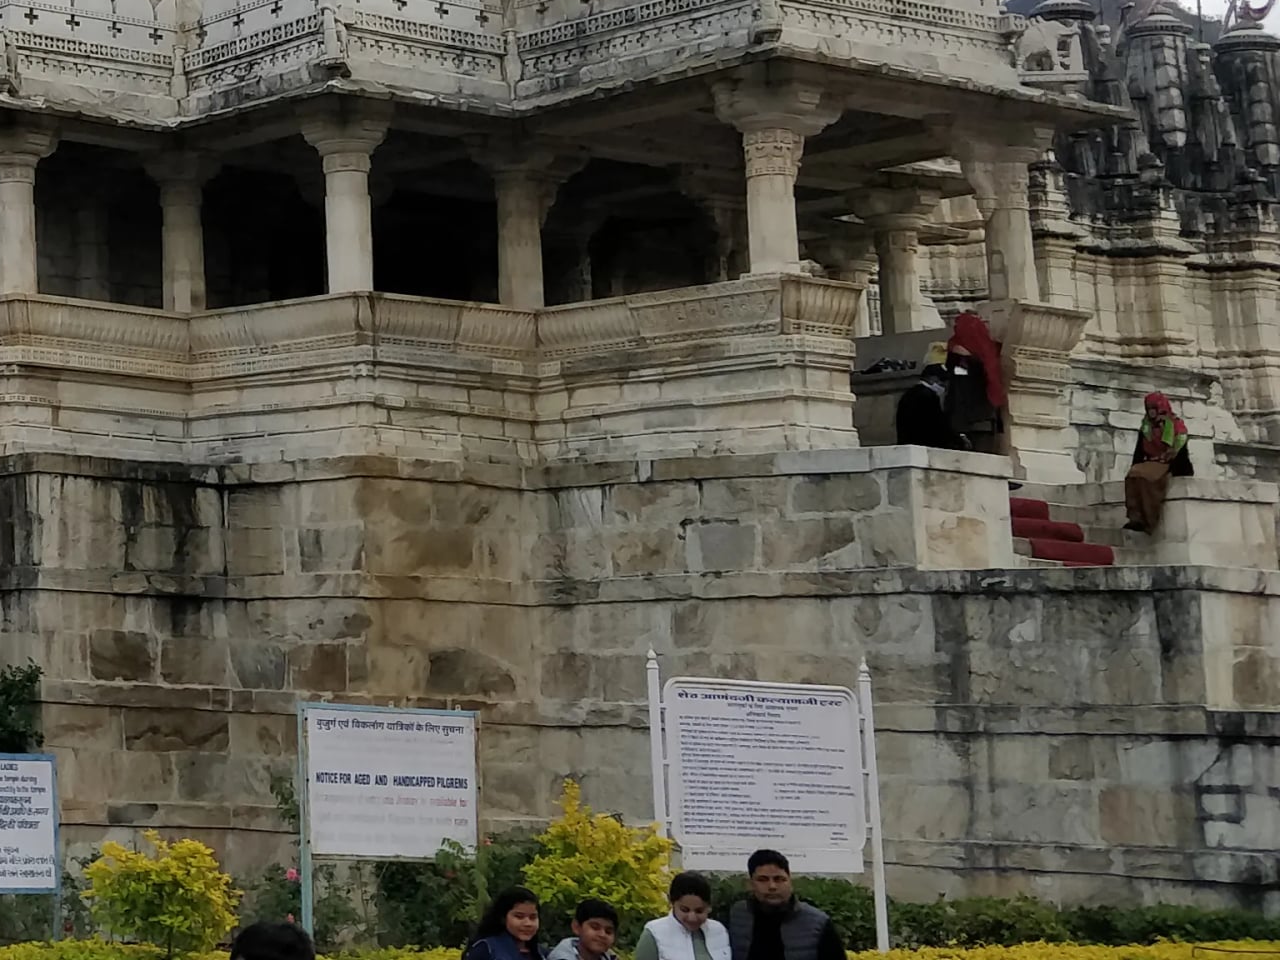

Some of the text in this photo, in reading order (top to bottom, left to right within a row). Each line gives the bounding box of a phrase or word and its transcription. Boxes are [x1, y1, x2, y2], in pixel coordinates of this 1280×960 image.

[0, 763, 19, 772] LADIES
[316, 772, 338, 784] NOTICE
[339, 773, 351, 784] FOR
[354, 773, 371, 785] AGED
[375, 774, 388, 786] AND
[393, 776, 435, 787] HANDICAPPED
